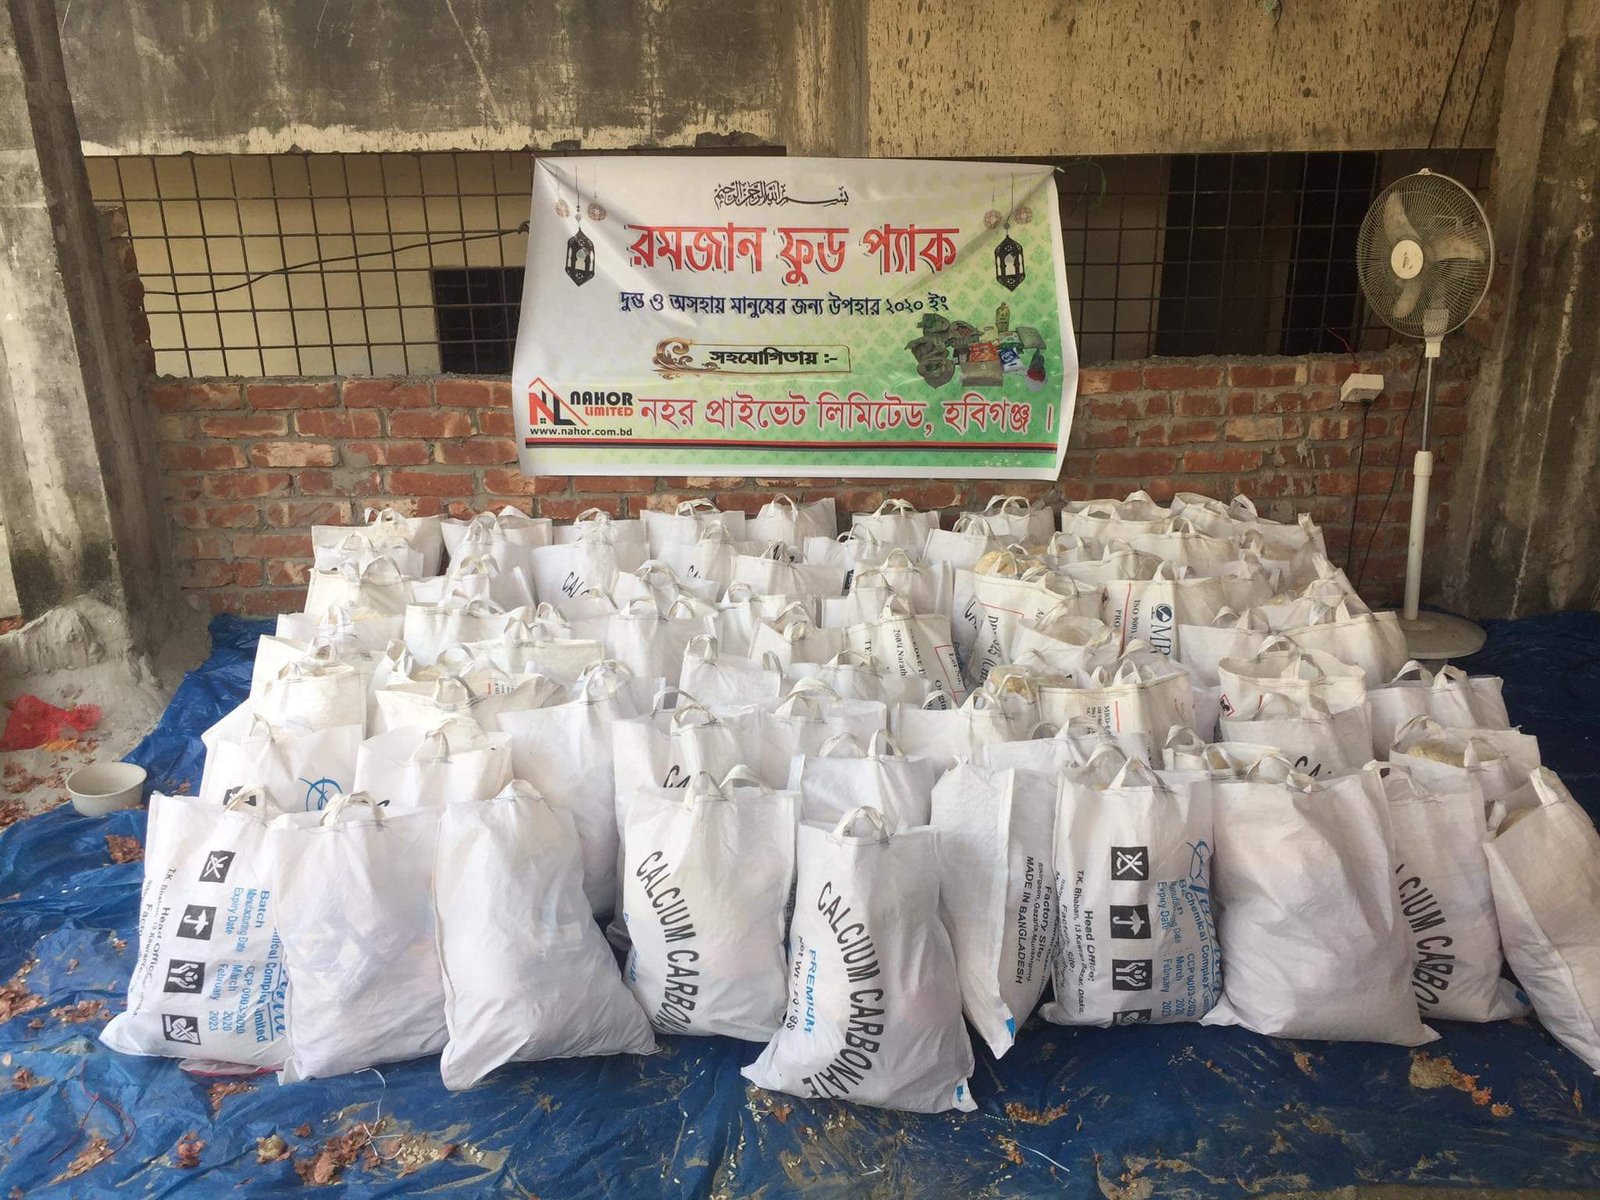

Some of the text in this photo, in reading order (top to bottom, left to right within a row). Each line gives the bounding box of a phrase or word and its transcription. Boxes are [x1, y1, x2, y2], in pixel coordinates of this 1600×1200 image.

[625, 222, 959, 285] রমজান ফুড প্যাক
[650, 293, 664, 311] ও
[669, 294, 725, 314] অসহায়
[730, 296, 787, 318] মানুষের
[791, 298, 824, 315] জন্য
[828, 291, 881, 315] উপহার
[886, 298, 924, 315] ২০২০
[928, 291, 949, 312] ইং
[709, 347, 819, 365] সহযোগিতায়
[570, 391, 633, 406] NAHOR
[585, 406, 634, 417] LIMITED
[638, 398, 698, 431] নহর
[705, 391, 809, 432] প্রাইভেট
[816, 390, 933, 437] লিমিটেড,
[943, 392, 1031, 435] হবিগঞ্জ
[530, 427, 633, 436] www.nahor.com.bd
[1075, 870, 1084, 885] T.K.
[225, 887, 243, 935] Expiry Date
[255, 890, 270, 928] Batch
[636, 851, 697, 943] CALCIUM
[1073, 887, 1083, 920] Bhaban,
[1157, 881, 1170, 930] Expiry Date
[235, 888, 257, 953] Manufacturing Date
[1016, 856, 1034, 985] MADE IN BANGLADESH
[1036, 886, 1051, 962] Factory Site:
[1084, 910, 1095, 941] Head
[1185, 891, 1208, 942] Chemical
[1201, 945, 1210, 988] Complex
[244, 965, 256, 986] CCP
[1160, 959, 1172, 993] February
[1174, 956, 1185, 982] March
[1186, 953, 1195, 975] CCP
[208, 964, 229, 1031] February 2023
[222, 964, 244, 1032] March 2020
[801, 881, 885, 1099] CALCIUM CARBONATE
[804, 949, 818, 1035] PREMIUM
[254, 1008, 269, 1043] imited
